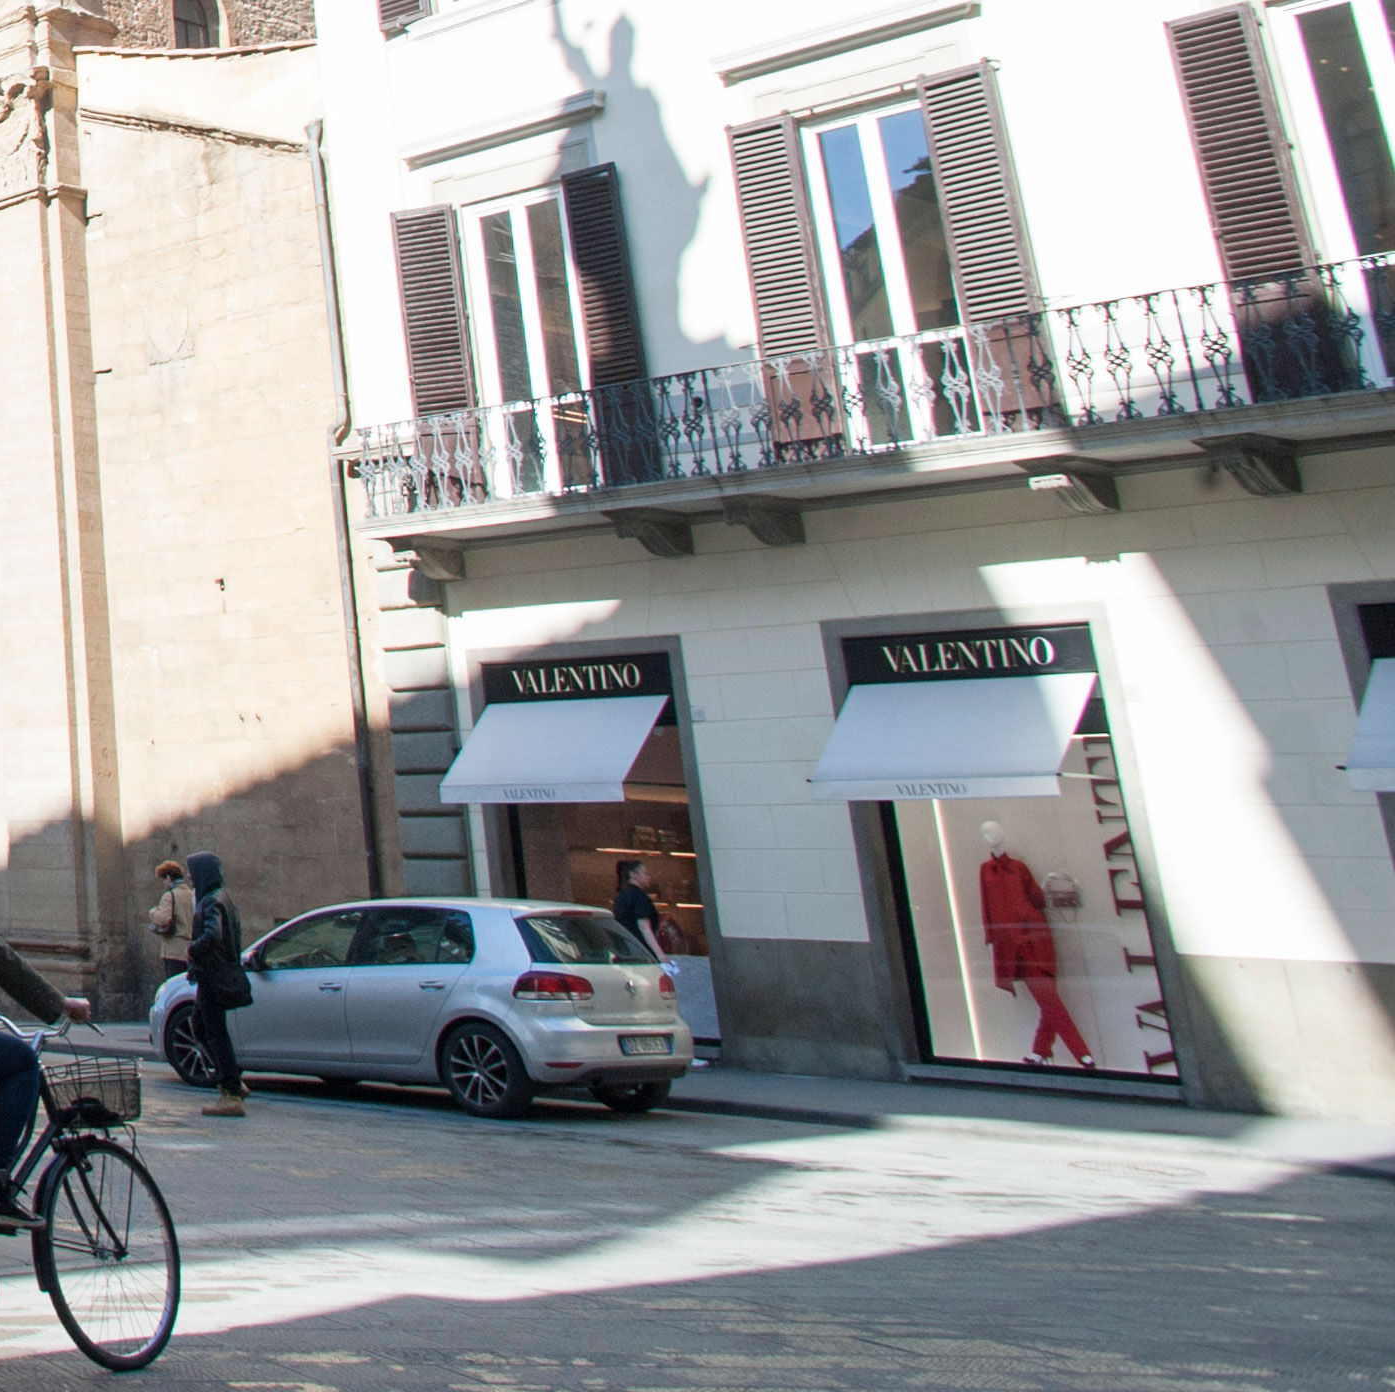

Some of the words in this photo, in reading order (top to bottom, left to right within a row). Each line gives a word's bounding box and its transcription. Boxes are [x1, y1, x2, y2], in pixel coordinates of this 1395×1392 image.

[881, 636, 1056, 673] VALENTINO
[511, 662, 642, 695] VALENTINO
[503, 787, 557, 800] VALENTINO
[895, 782, 968, 797] VALENTINO
